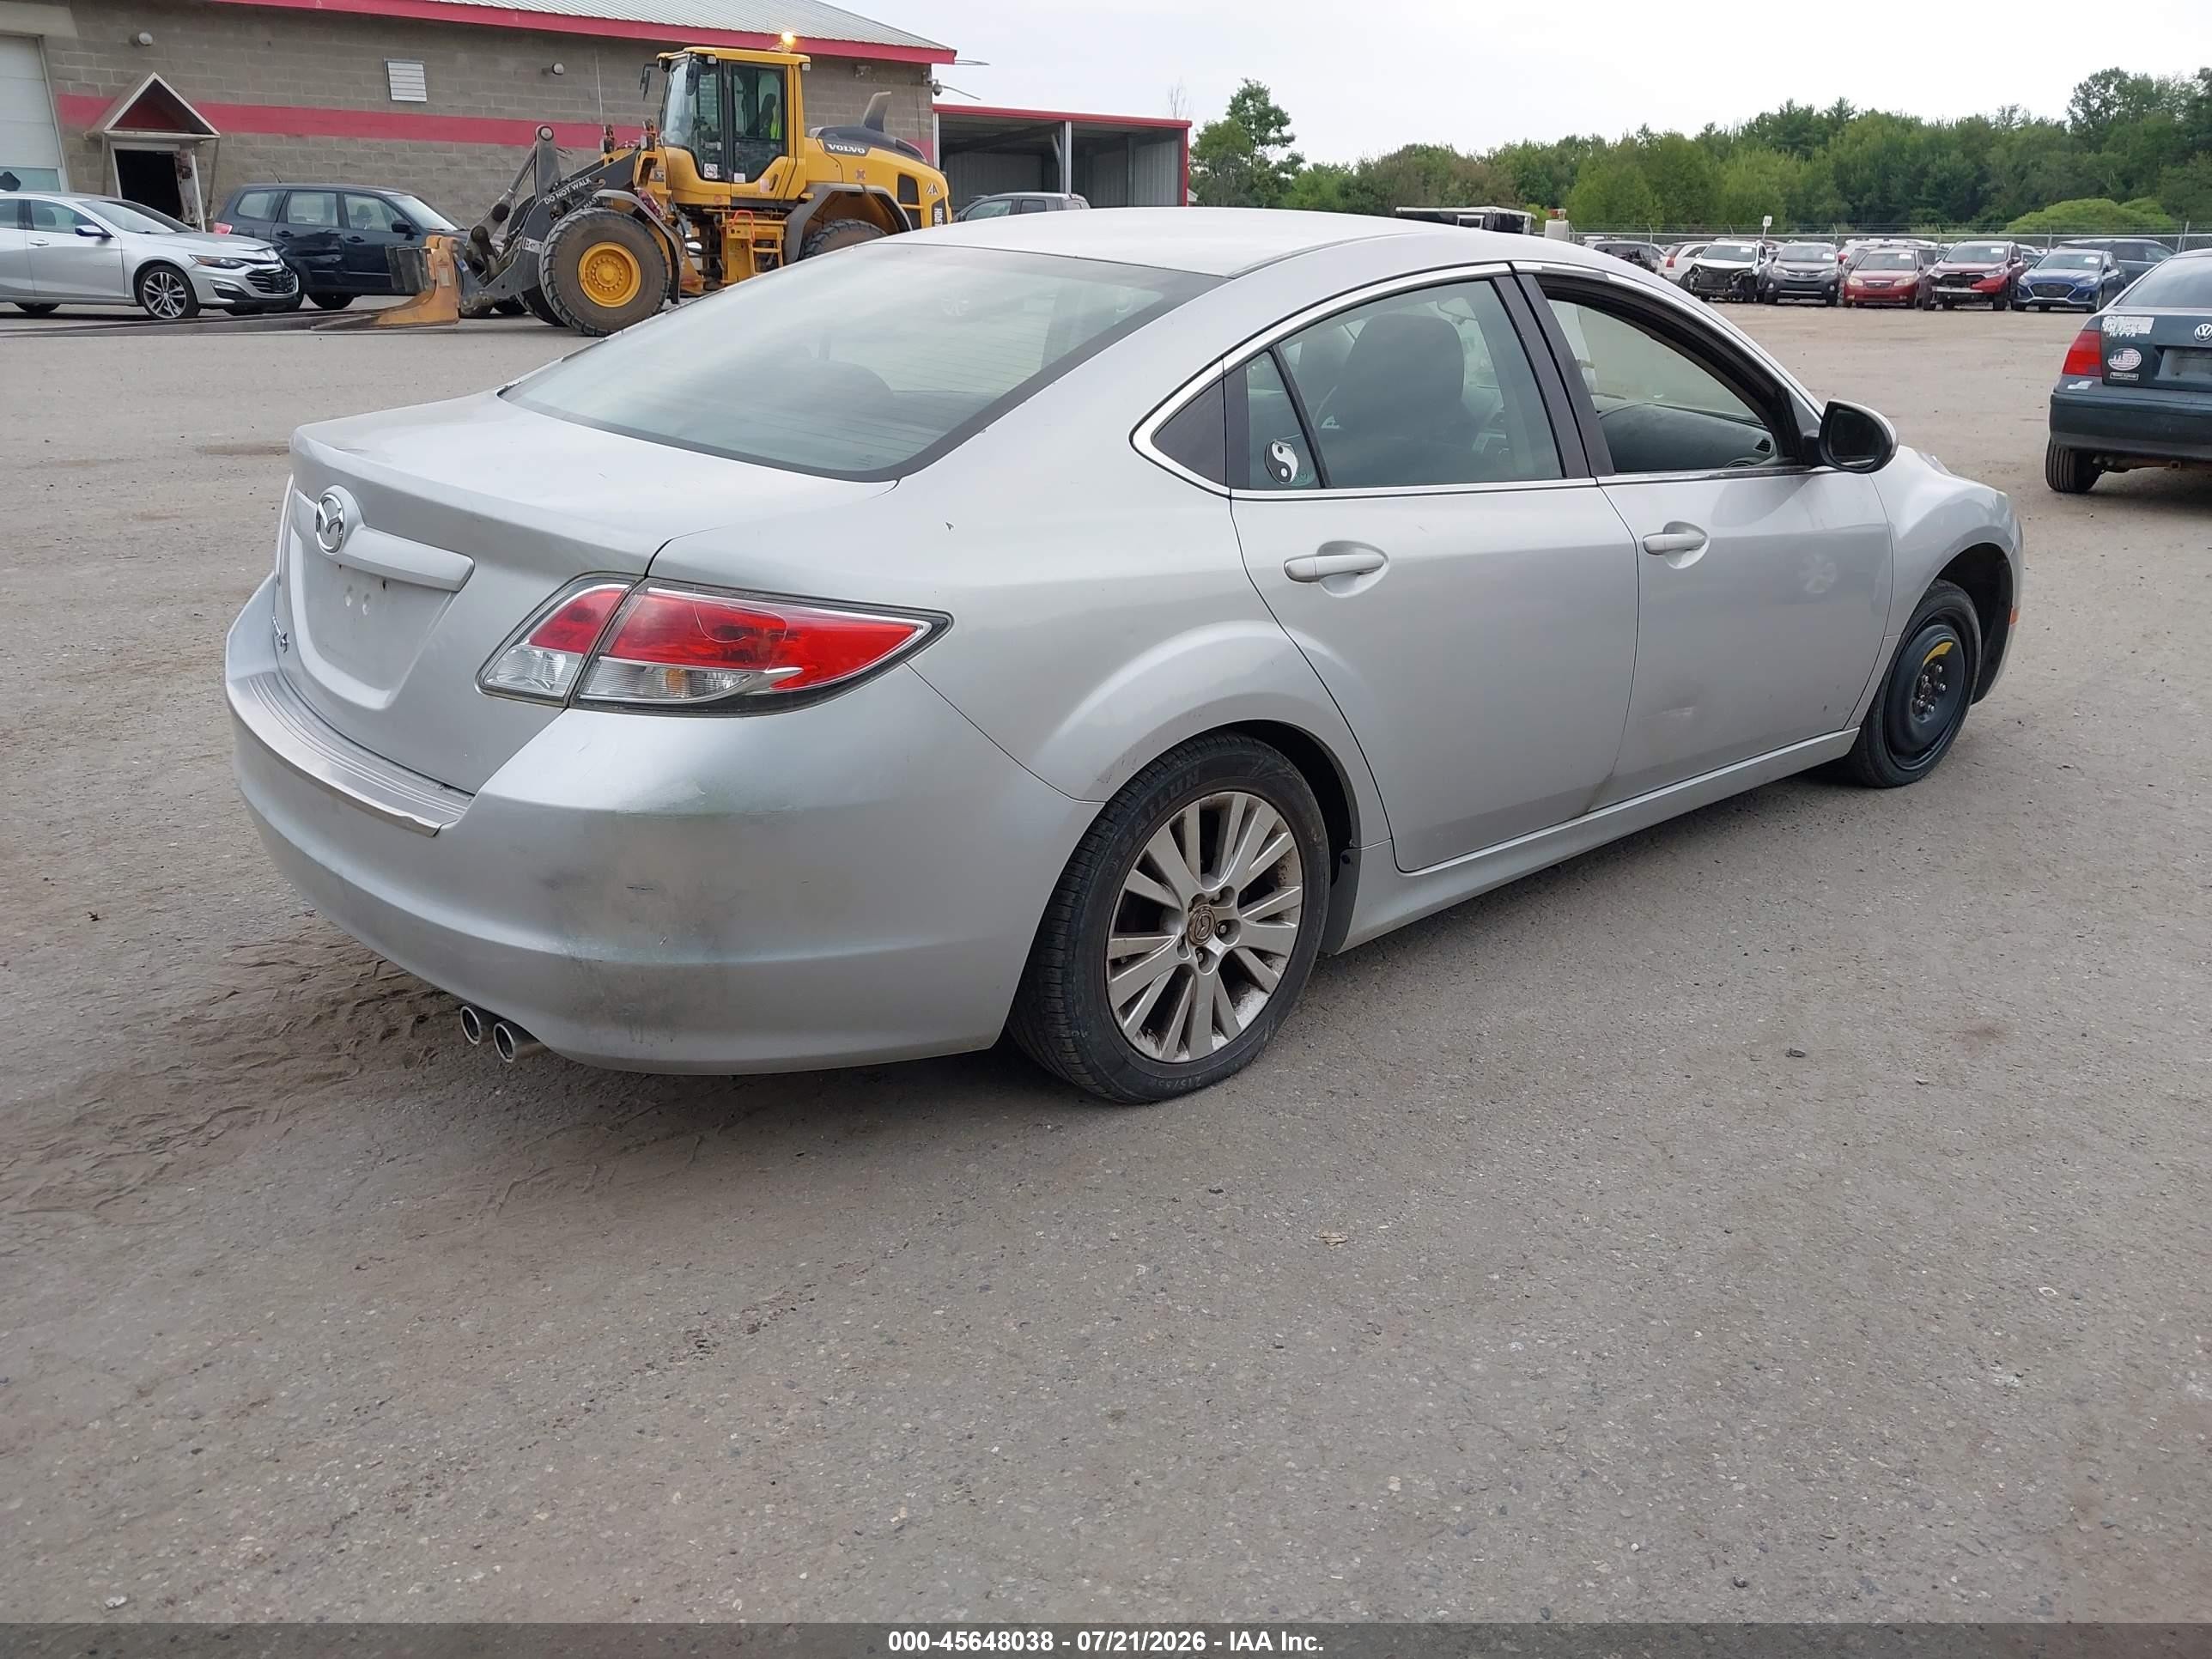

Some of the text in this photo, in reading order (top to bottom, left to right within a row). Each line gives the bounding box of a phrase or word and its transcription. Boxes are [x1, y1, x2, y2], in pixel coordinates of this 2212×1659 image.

[827, 143, 866, 154] VOLVO
[544, 177, 592, 205] DO NOT WALK
